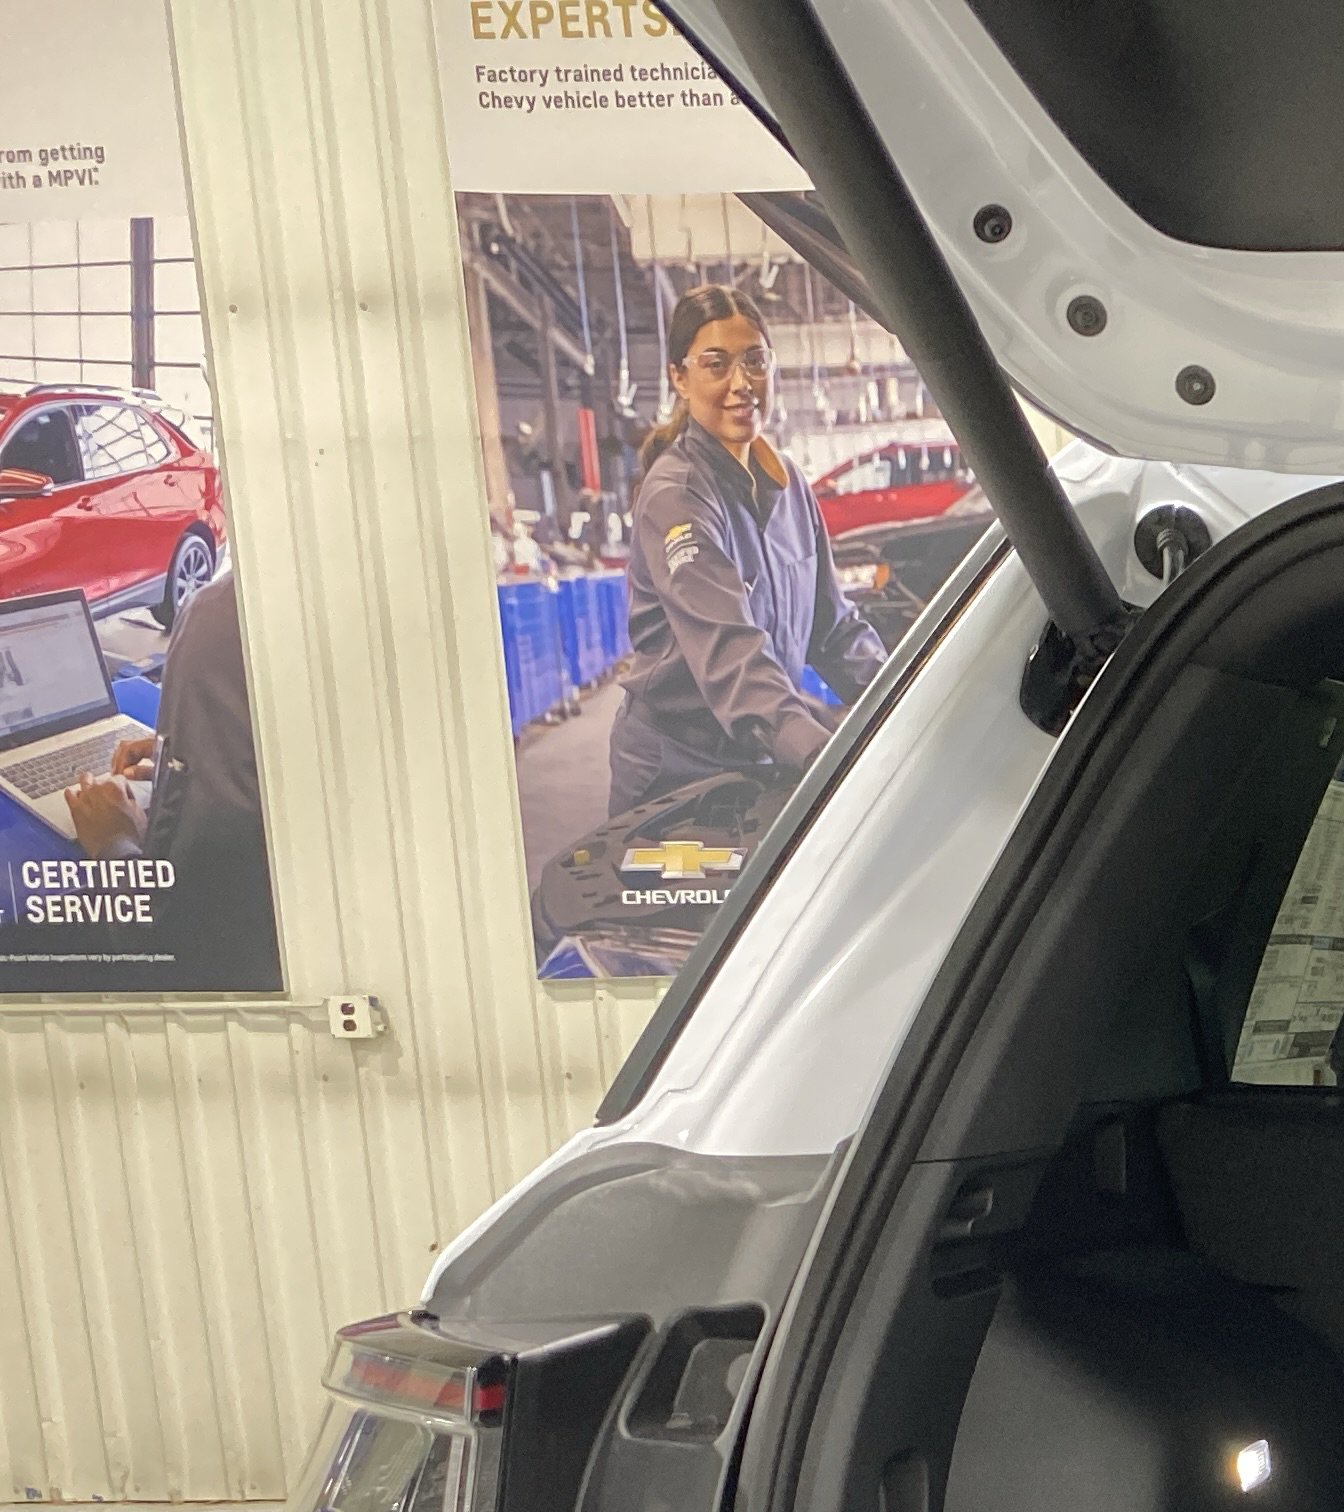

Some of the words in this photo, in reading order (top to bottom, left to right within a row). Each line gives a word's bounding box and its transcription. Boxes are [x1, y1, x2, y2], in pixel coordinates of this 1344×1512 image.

[475, 65, 549, 87] Factory
[554, 64, 623, 82] trained
[630, 62, 717, 81] technicia
[479, 91, 536, 113] Chevy
[542, 90, 609, 109] vehicle
[614, 90, 674, 108] better
[680, 88, 723, 107] than
[730, 91, 740, 105] a
[39, 142, 105, 166] getting
[0, 171, 26, 189] ith
[32, 174, 42, 188] a
[22, 860, 176, 888] CERTIFIED
[26, 895, 153, 923] SERVICE
[621, 889, 731, 905] CHEVROL
